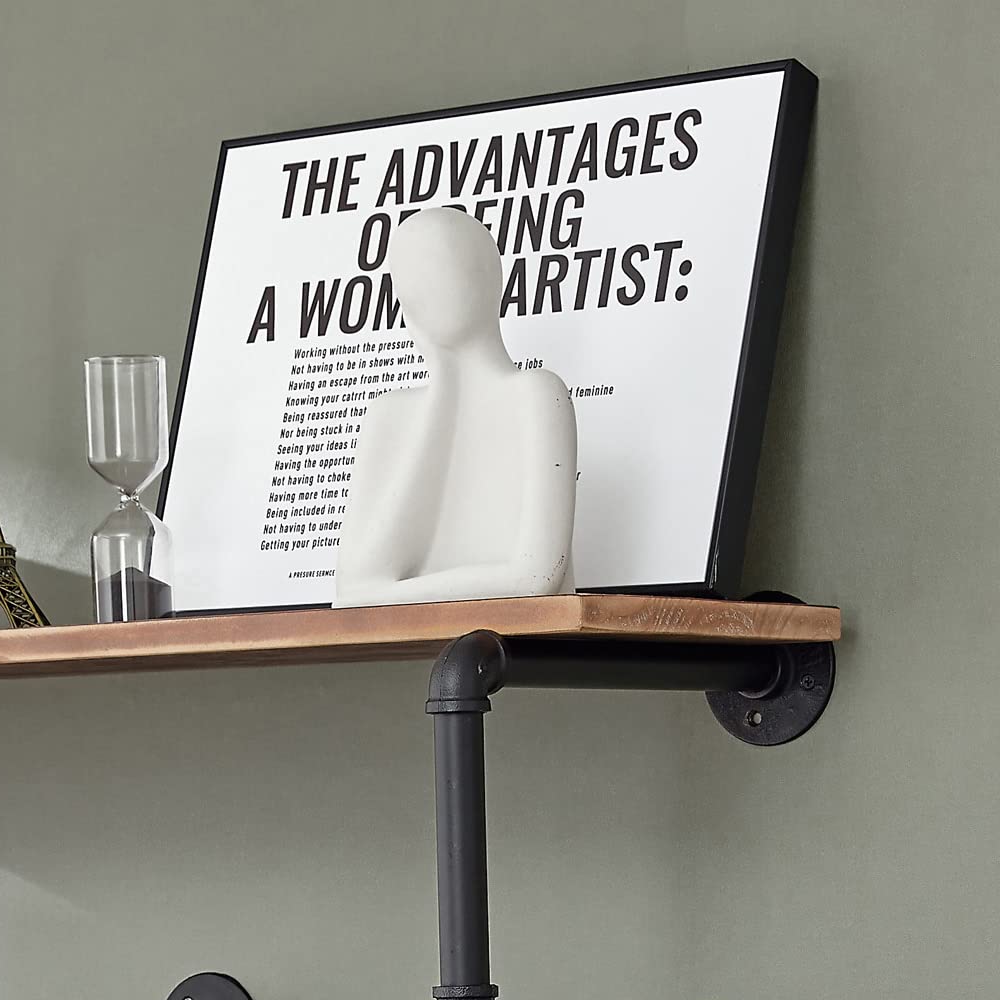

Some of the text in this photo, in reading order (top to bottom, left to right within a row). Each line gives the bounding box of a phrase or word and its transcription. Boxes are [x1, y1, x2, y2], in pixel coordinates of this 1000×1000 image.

[282, 109, 702, 218] THE ADVANTAGES
[246, 240, 693, 344] A WOM ARTIST:
[294, 340, 414, 359] Working without the pressure
[290, 364, 304, 374] Not
[306, 361, 333, 374] having
[336, 361, 344, 370] to
[346, 359, 355, 369] be
[358, 358, 366, 368] in
[368, 357, 394, 367] shows
[397, 353, 414, 365] with
[524, 357, 543, 370] jobs
[288, 370, 429, 391] Having an escape from the art wor
[575, 384, 613, 397] feminine
[285, 394, 319, 406] Knowing
[320, 394, 339, 406] your
[282, 406, 367, 423] Being reassured that
[296, 426, 317, 438] being
[320, 423, 342, 435] stuck
[344, 422, 352, 433] in
[355, 424, 360, 432] a
[276, 443, 303, 455] Seeing
[305, 443, 324, 454] your
[326, 440, 347, 450] ideas
[274, 455, 355, 471] Having the opportun
[271, 471, 351, 486] Not having to choke
[268, 491, 295, 503] Having
[298, 491, 318, 500] more
[320, 487, 338, 498] time
[266, 507, 288, 519] Being
[290, 504, 325, 516] included
[327, 503, 335, 514] in
[263, 519, 342, 534] Not having to under
[260, 539, 289, 551] Getting
[291, 539, 309, 551] your
